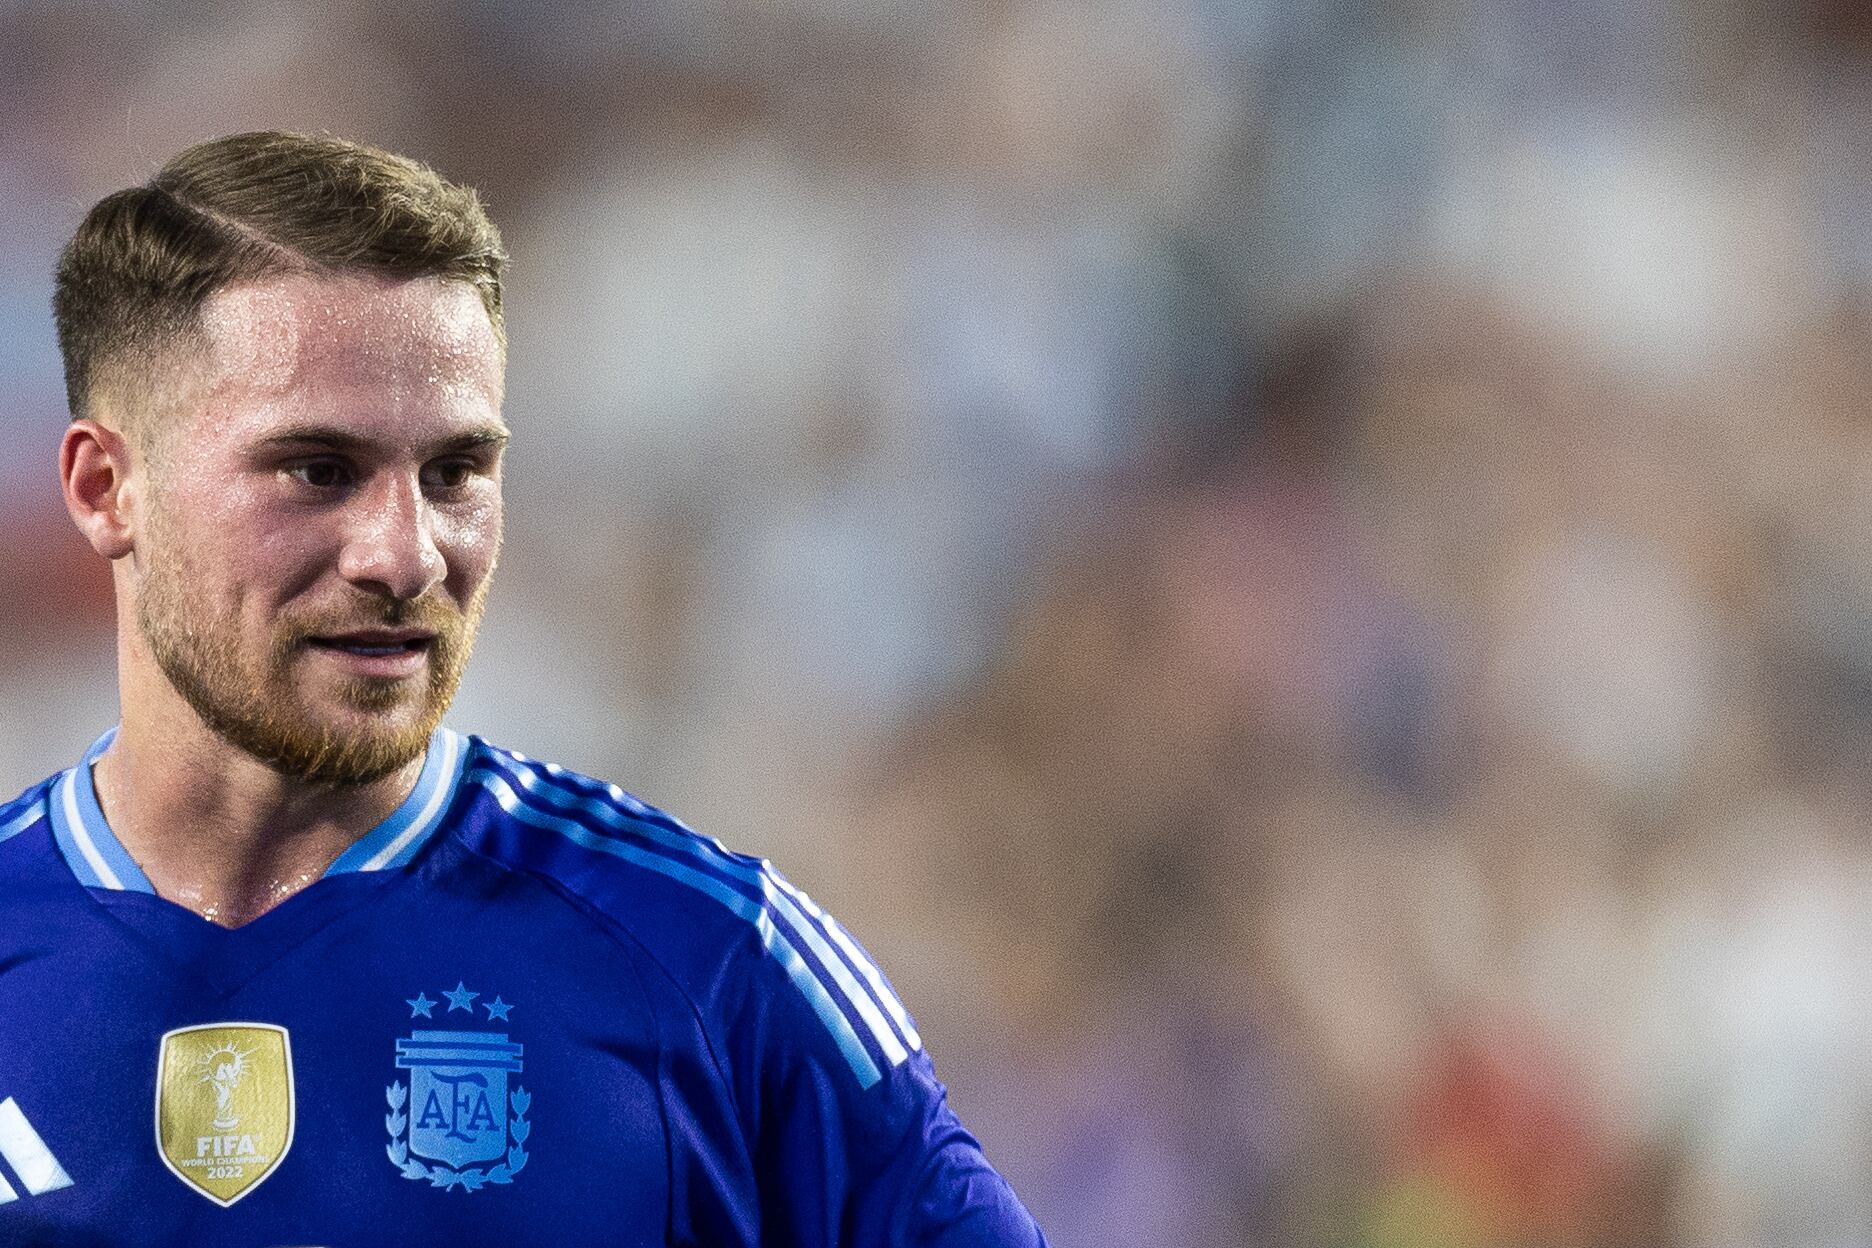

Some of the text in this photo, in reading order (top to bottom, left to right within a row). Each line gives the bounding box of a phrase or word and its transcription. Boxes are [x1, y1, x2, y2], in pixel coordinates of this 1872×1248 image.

[417, 1071, 500, 1144] AFA
[197, 1135, 255, 1157] FIFA
[181, 1157, 215, 1167] WORLD
[207, 1166, 244, 1179] 2022
